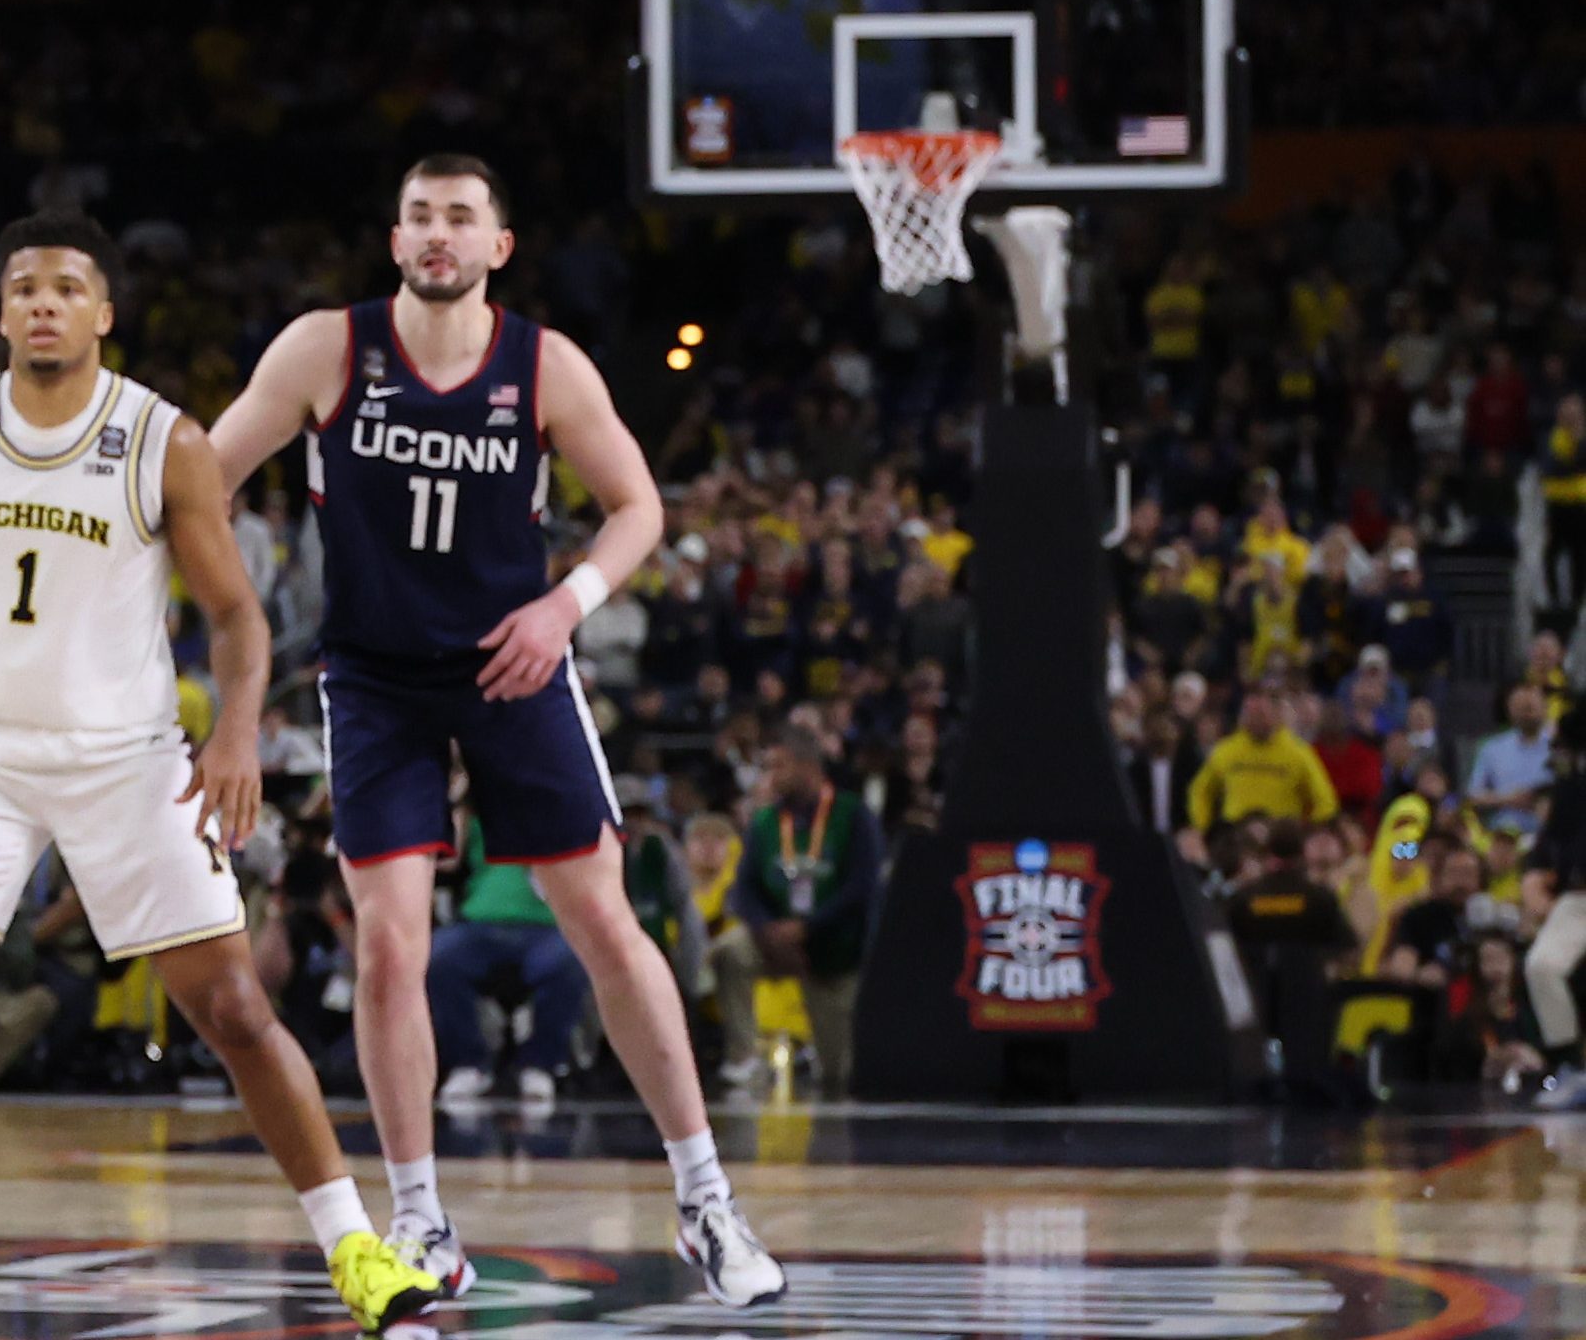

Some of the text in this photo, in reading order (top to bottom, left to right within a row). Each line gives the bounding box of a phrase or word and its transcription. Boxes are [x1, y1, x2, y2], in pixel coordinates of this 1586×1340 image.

[351, 418, 518, 473] UCONN
[409, 475, 458, 553] 11
[10, 549, 39, 626] 1
[974, 872, 1087, 920] FINAL
[979, 954, 1085, 1001] FOUR
